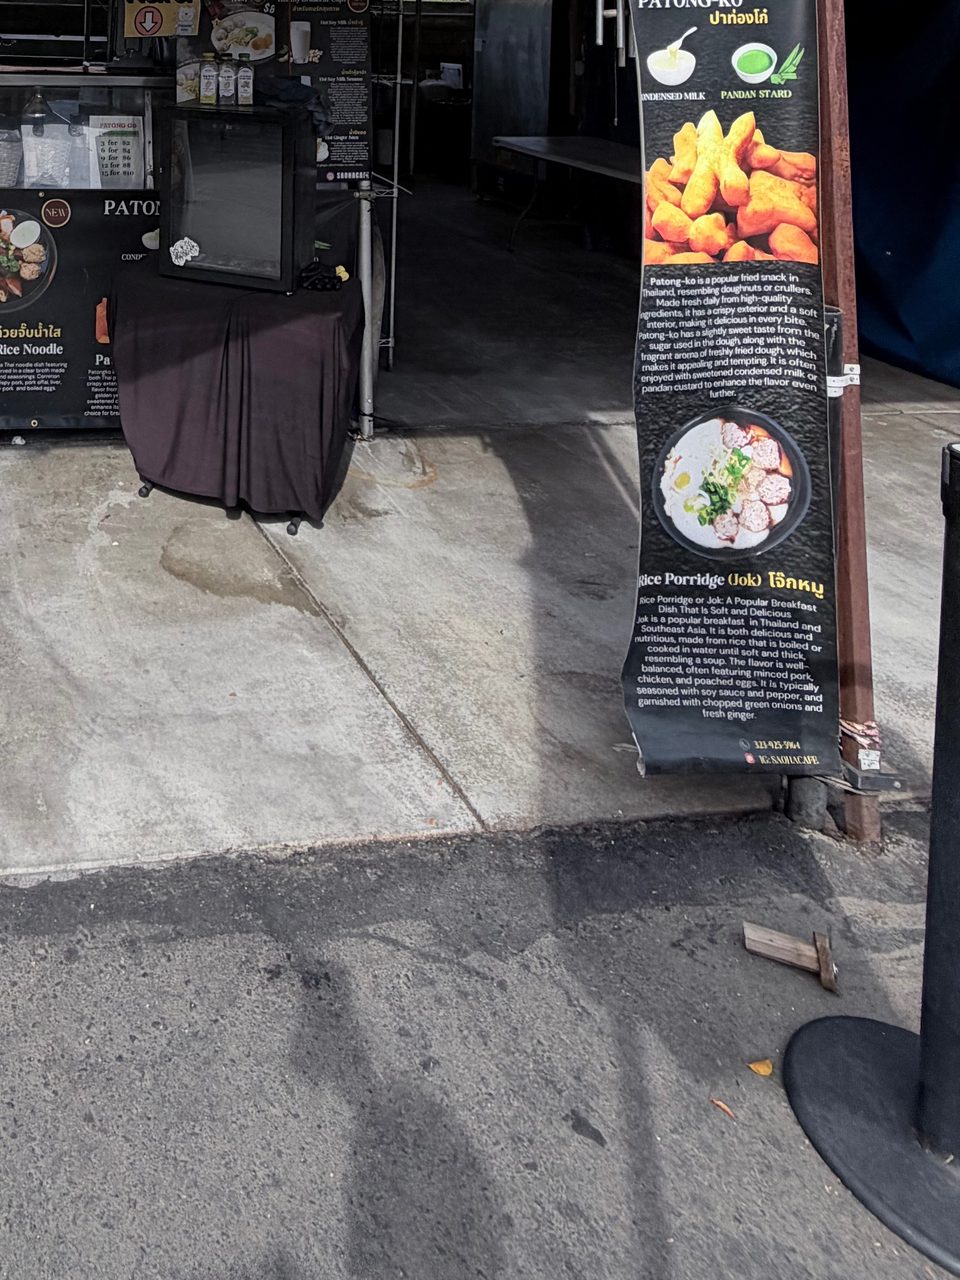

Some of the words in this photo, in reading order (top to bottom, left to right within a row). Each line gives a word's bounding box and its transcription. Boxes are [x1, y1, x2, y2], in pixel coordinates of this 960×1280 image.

[684, 91, 706, 100] MILK
[721, 90, 757, 99] PANDAN
[759, 89, 792, 99] STARD
[44, 207, 68, 218] NEW
[650, 276, 696, 287] Patong-ko
[697, 276, 704, 285] is
[711, 275, 740, 286] popular
[741, 273, 760, 282] fried
[761, 272, 787, 281] snack
[789, 272, 799, 283] in
[23, 343, 64, 356] Noodle
[665, 572, 724, 589] Porridge
[727, 572, 762, 587] (Jok)
[657, 596, 693, 606] Porridge
[726, 597, 733, 605] A
[734, 597, 769, 608] Popular
[771, 598, 818, 613] Breakfast
